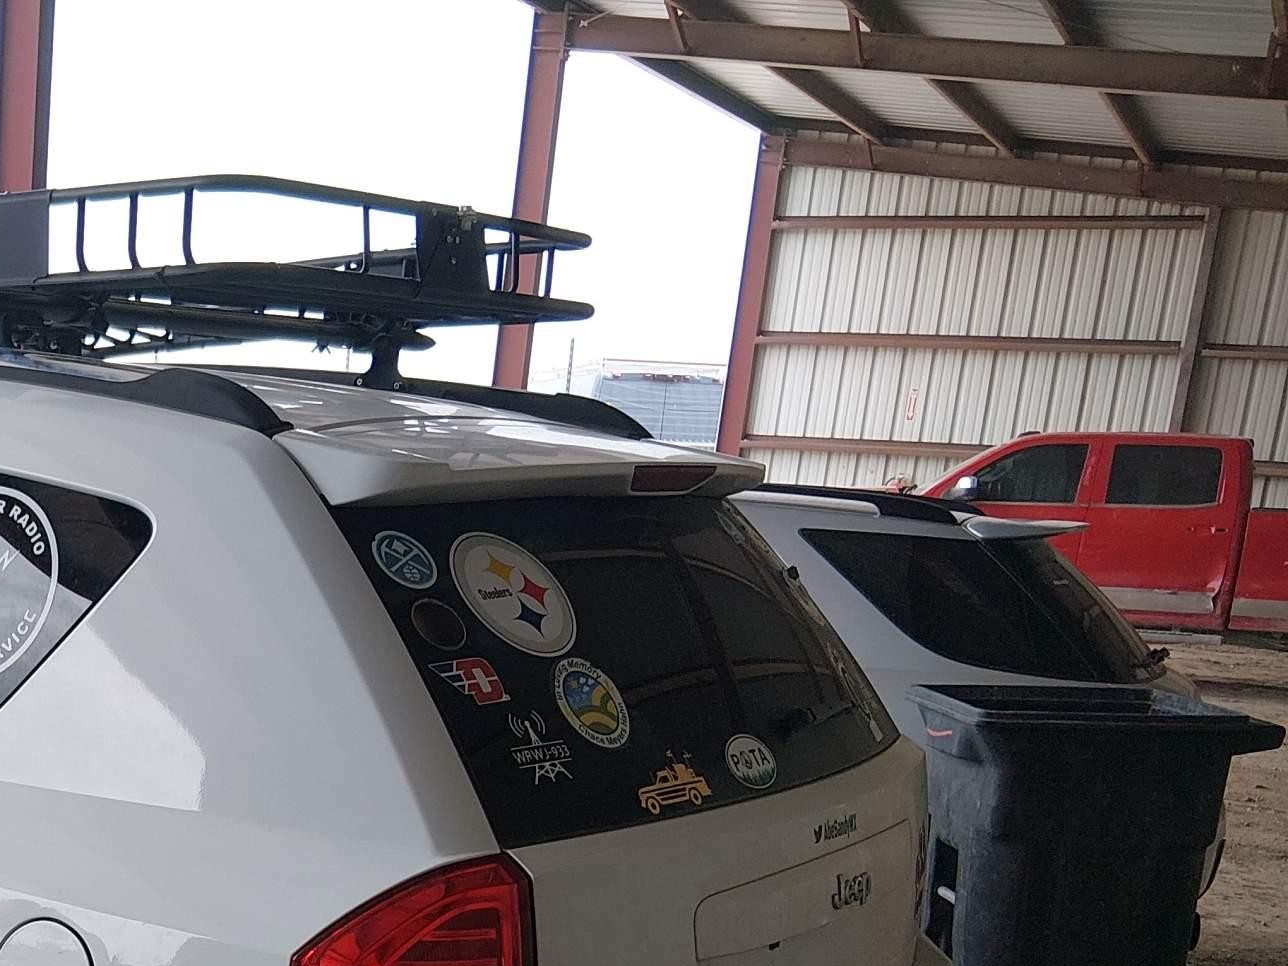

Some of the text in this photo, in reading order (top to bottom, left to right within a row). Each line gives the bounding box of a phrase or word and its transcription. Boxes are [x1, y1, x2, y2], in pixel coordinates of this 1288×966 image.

[9, 505, 45, 555] RADIO
[477, 586, 513, 600] Steelers
[567, 659, 602, 680] Memory
[730, 747, 770, 773] POTA
[831, 871, 872, 911] Jeep
